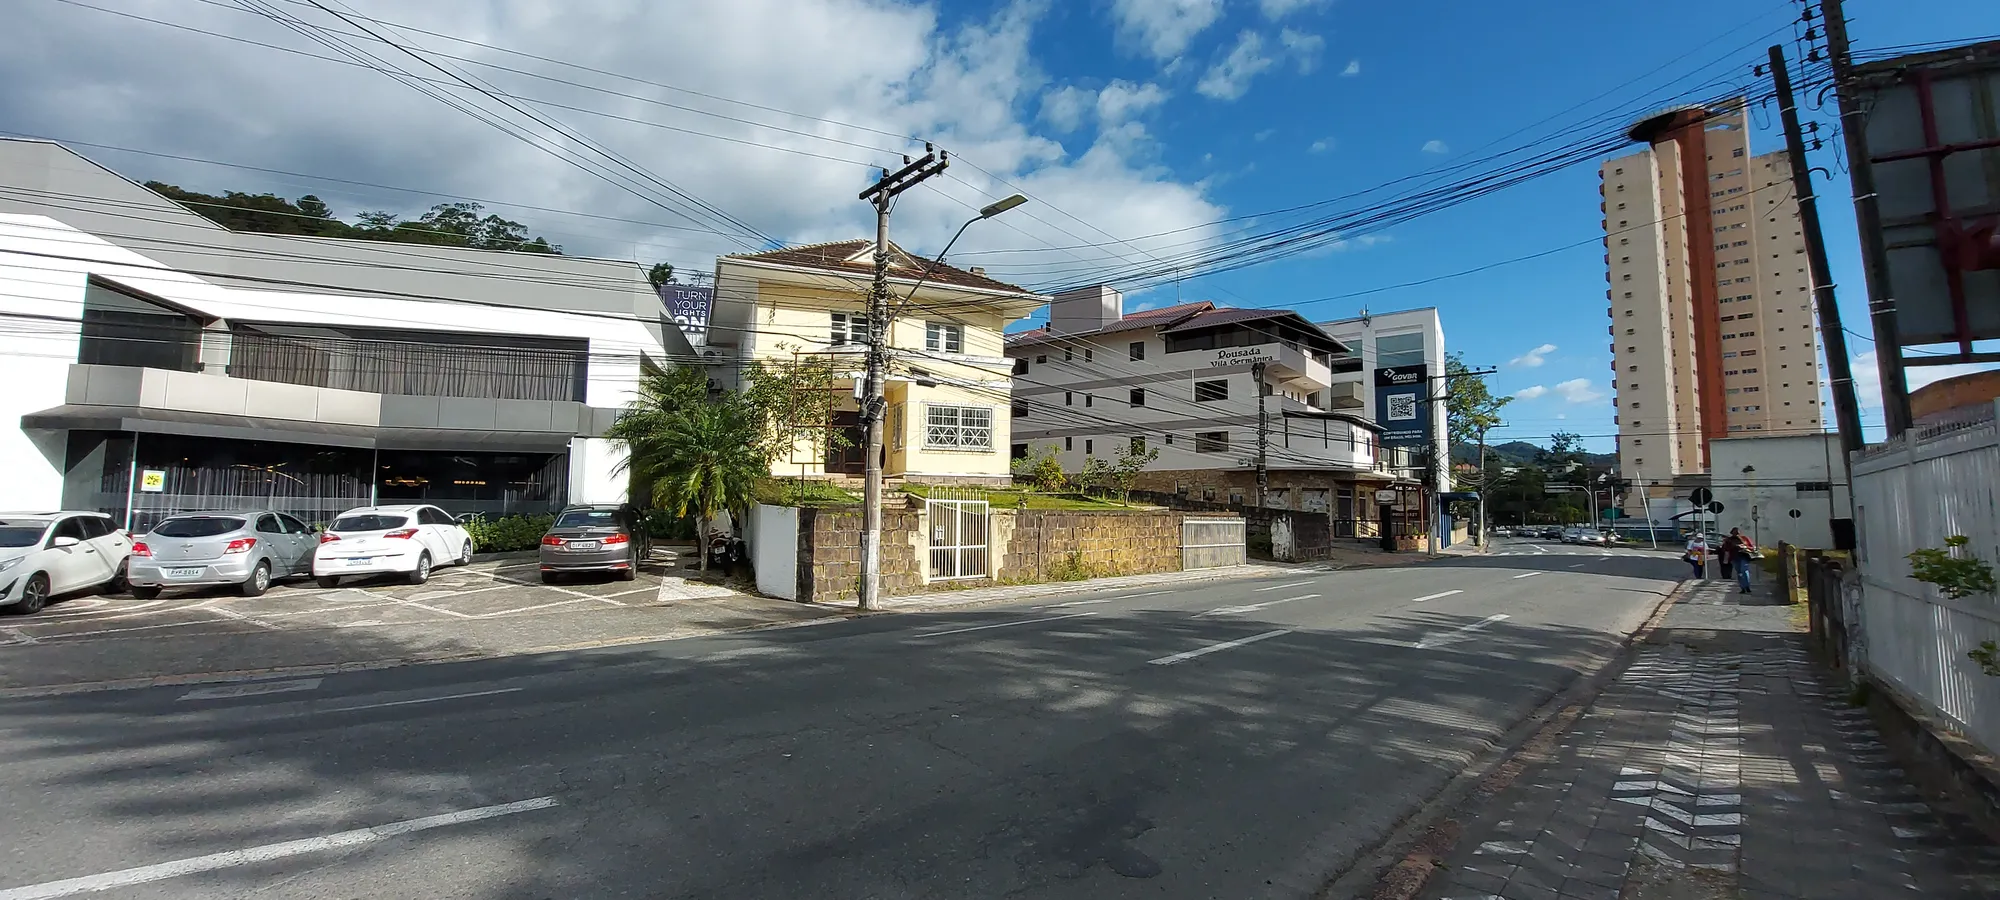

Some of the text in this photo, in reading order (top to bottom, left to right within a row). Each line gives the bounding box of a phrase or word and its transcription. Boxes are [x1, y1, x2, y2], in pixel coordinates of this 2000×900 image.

[675, 290, 707, 300] TURN
[674, 300, 707, 310] YOUR
[674, 315, 706, 332] ON
[1217, 347, 1261, 360] Pousada
[1210, 360, 1227, 368] Vila
[1392, 372, 1418, 381] GOVBR
